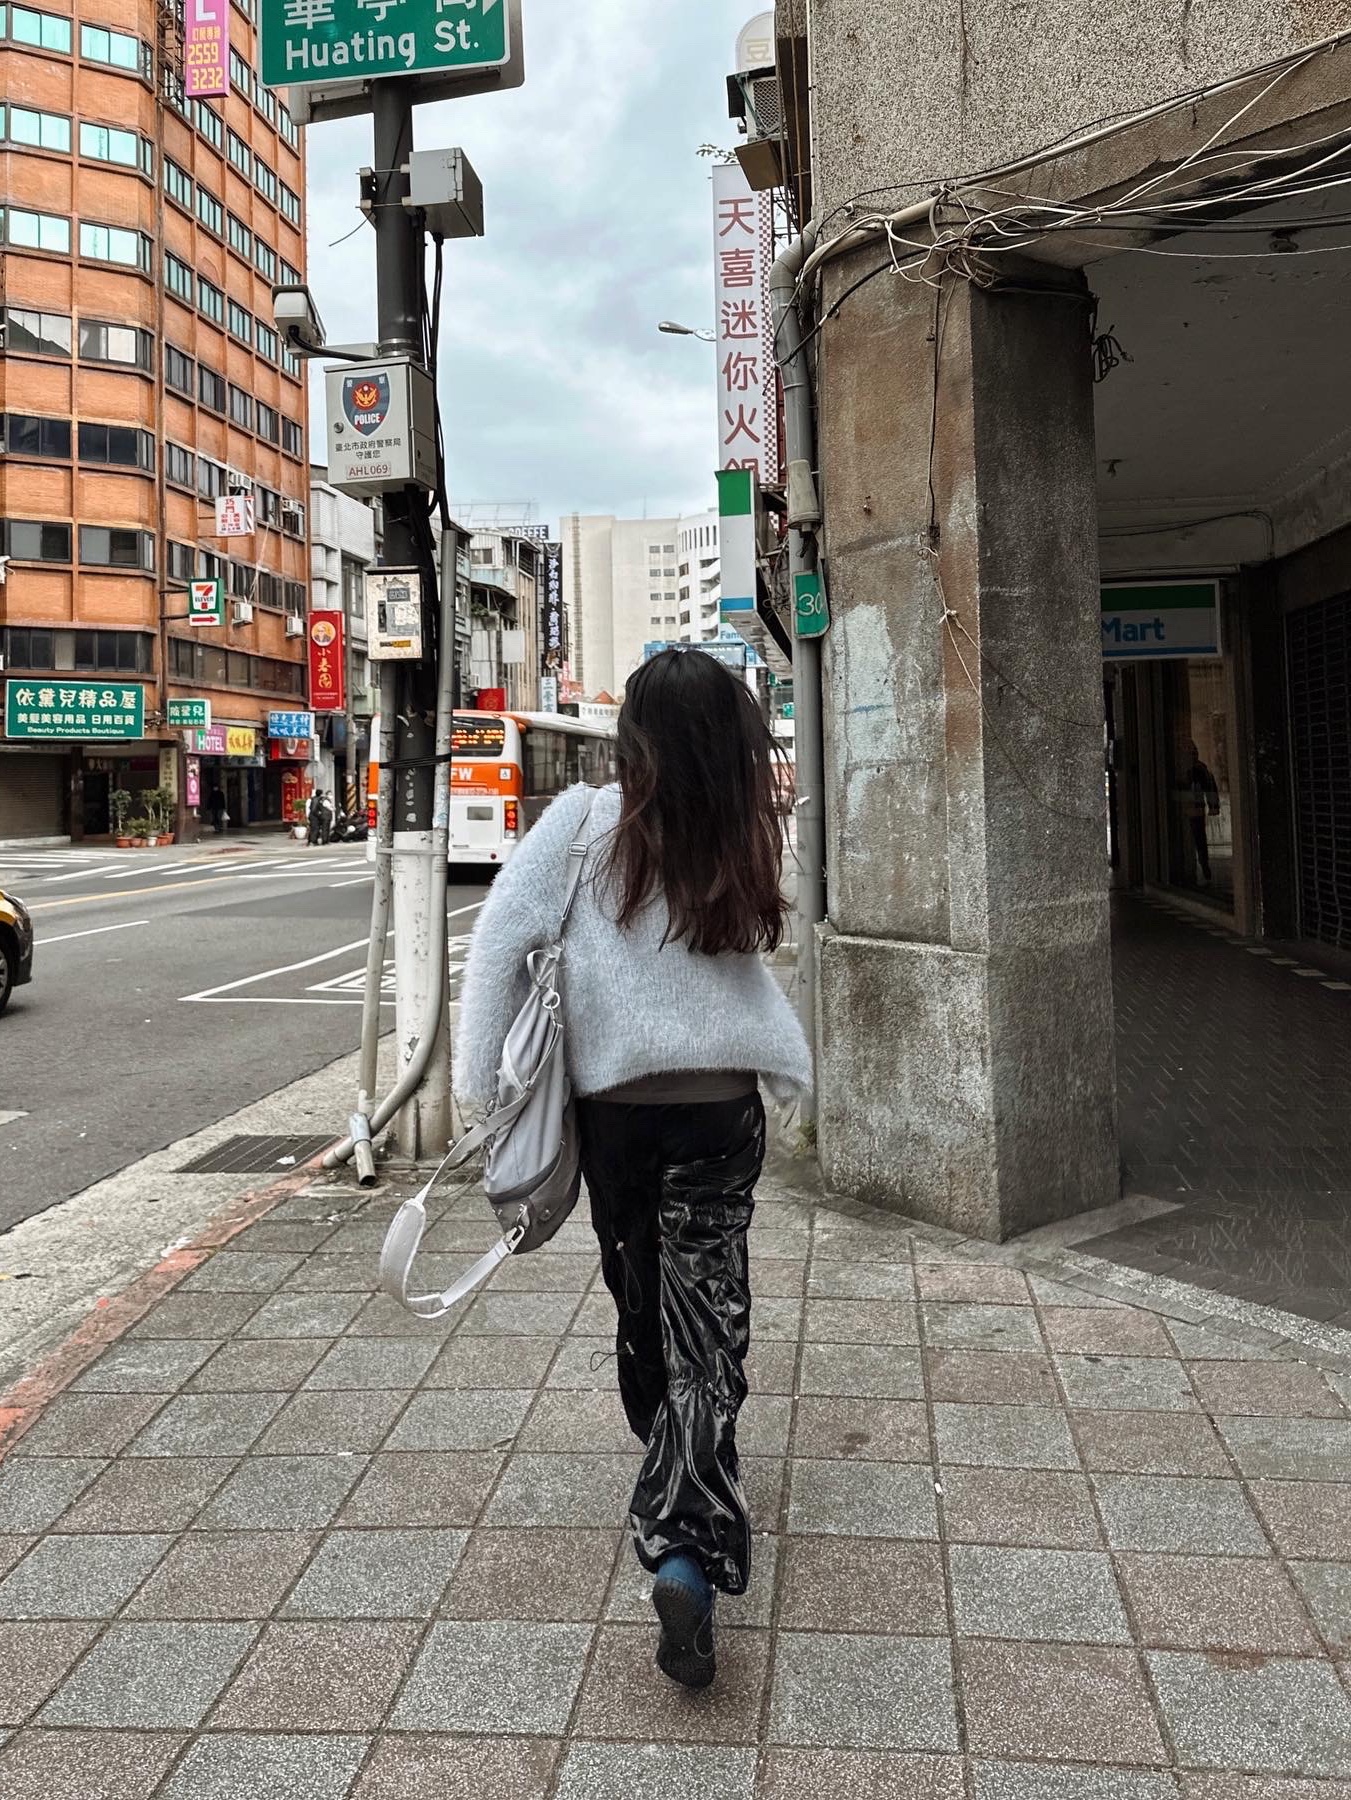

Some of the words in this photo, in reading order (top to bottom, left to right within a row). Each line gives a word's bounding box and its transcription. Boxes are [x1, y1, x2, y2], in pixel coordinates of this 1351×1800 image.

[188, 42, 219, 65] 2559
[286, 30, 416, 70] Huating
[434, 19, 480, 52] St.
[191, 67, 224, 90] 3232
[719, 198, 761, 480] 天喜迷你火
[354, 413, 381, 425] POLICE
[349, 464, 388, 477] AHL069
[195, 584, 214, 609] 7
[27, 726, 55, 735] Beauty
[56, 727, 90, 735] Products
[91, 727, 125, 736] Boutique
[197, 734, 225, 752] HOTEL
